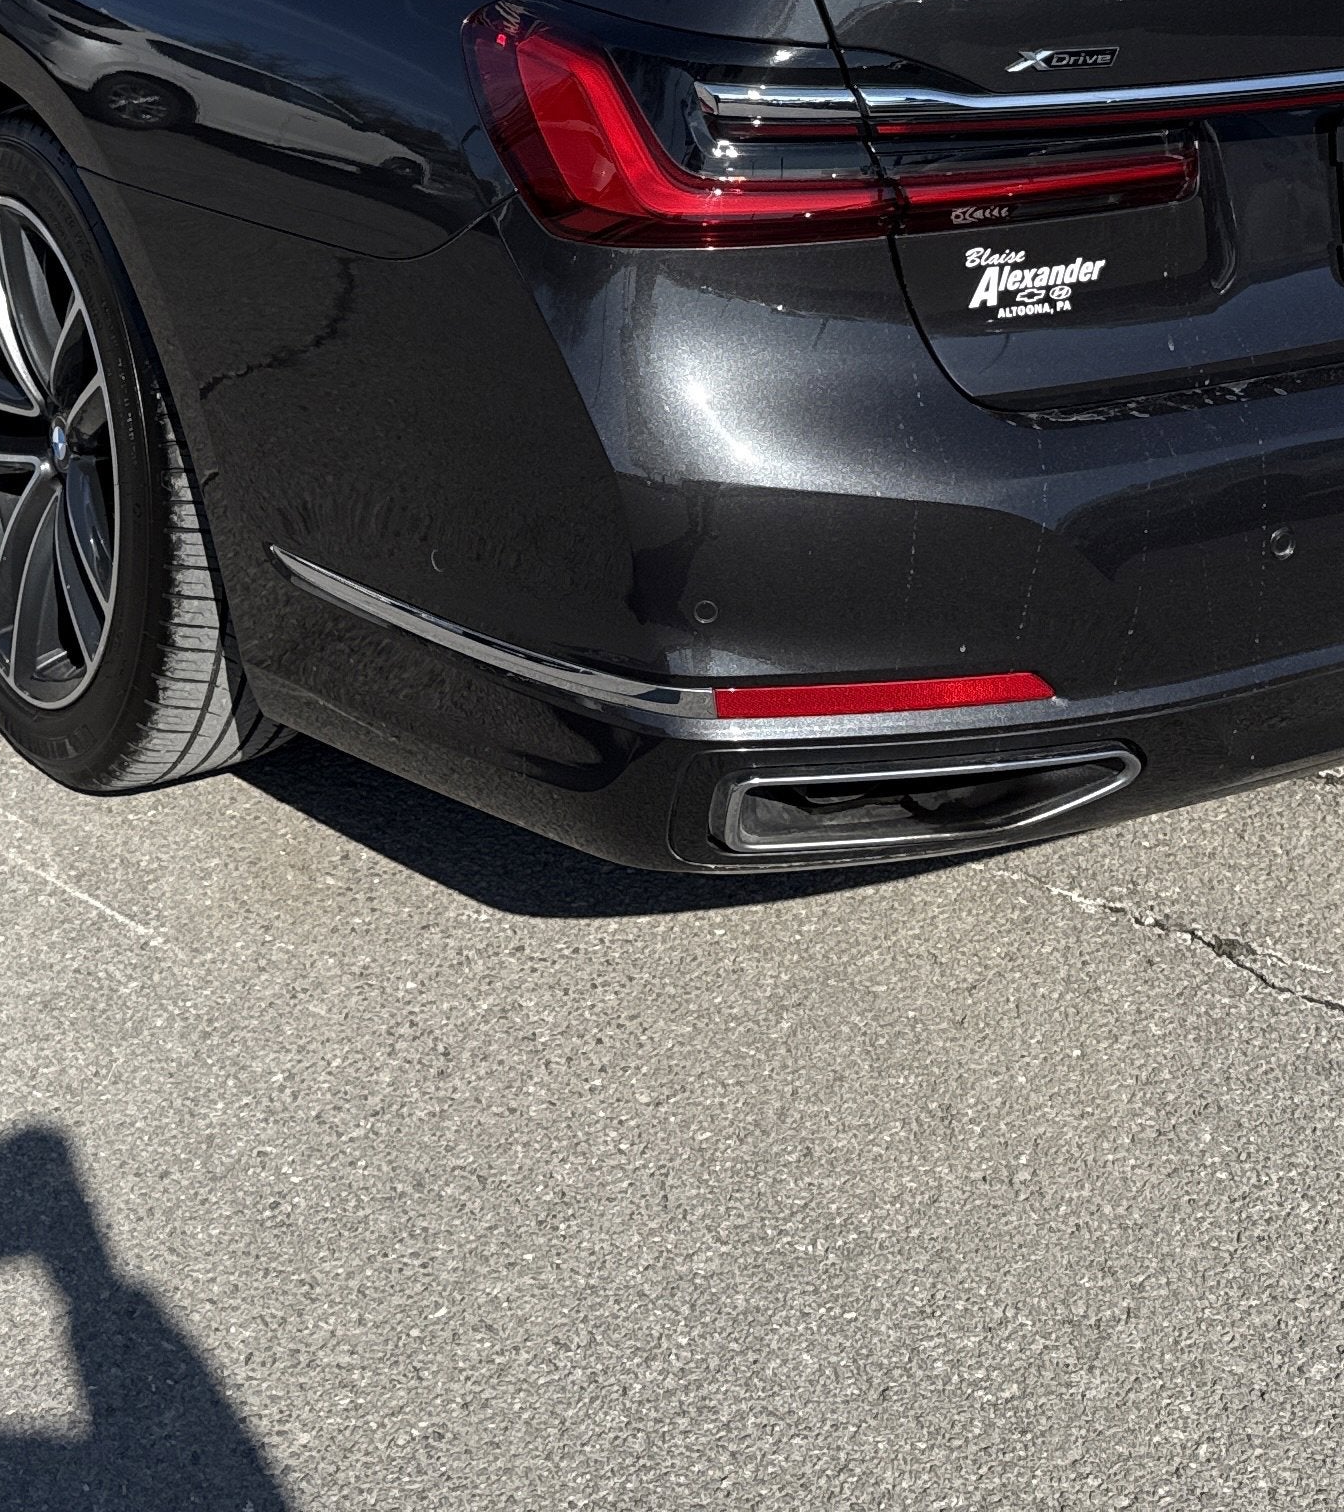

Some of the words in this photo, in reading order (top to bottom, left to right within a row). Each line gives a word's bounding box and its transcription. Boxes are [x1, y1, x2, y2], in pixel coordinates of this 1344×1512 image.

[965, 247, 1026, 268] Blaise
[968, 257, 1106, 309] Alexander
[997, 302, 1054, 318] ALTOONA,
[1056, 300, 1072, 312] PA
